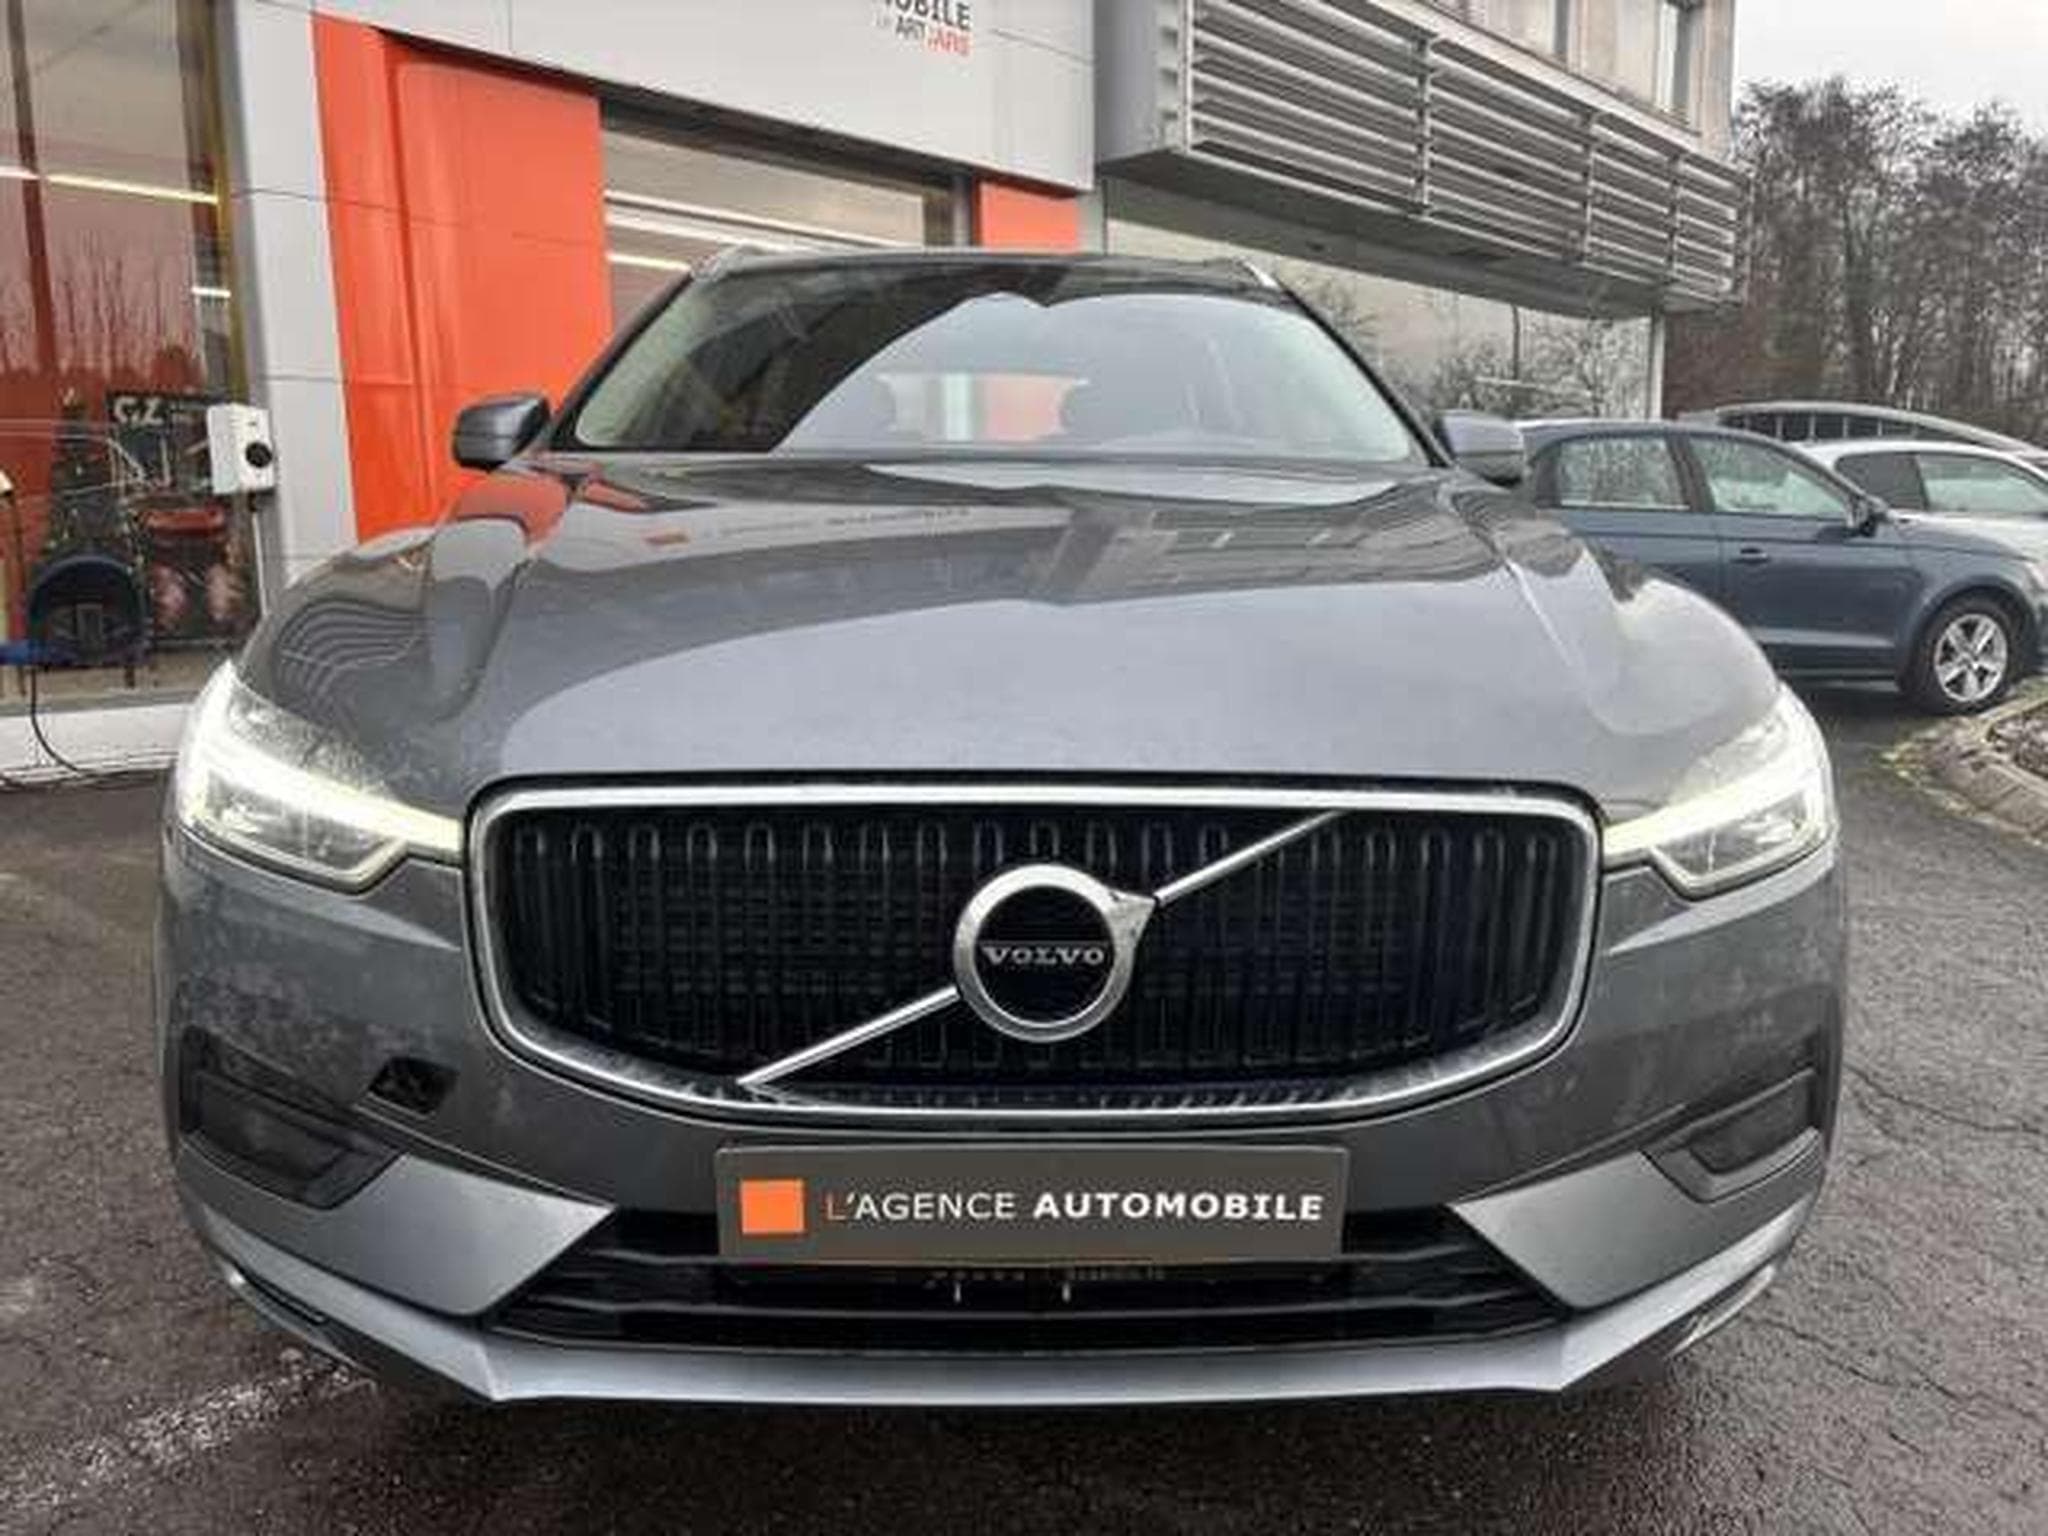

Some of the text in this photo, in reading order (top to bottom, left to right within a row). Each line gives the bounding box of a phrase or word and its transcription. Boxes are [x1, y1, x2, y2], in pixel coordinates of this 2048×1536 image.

[880, 0, 970, 31] OBILE
[982, 947, 1105, 965] VOLVO
[826, 1191, 1323, 1222] L'AGENCE AUTOMOBILE
